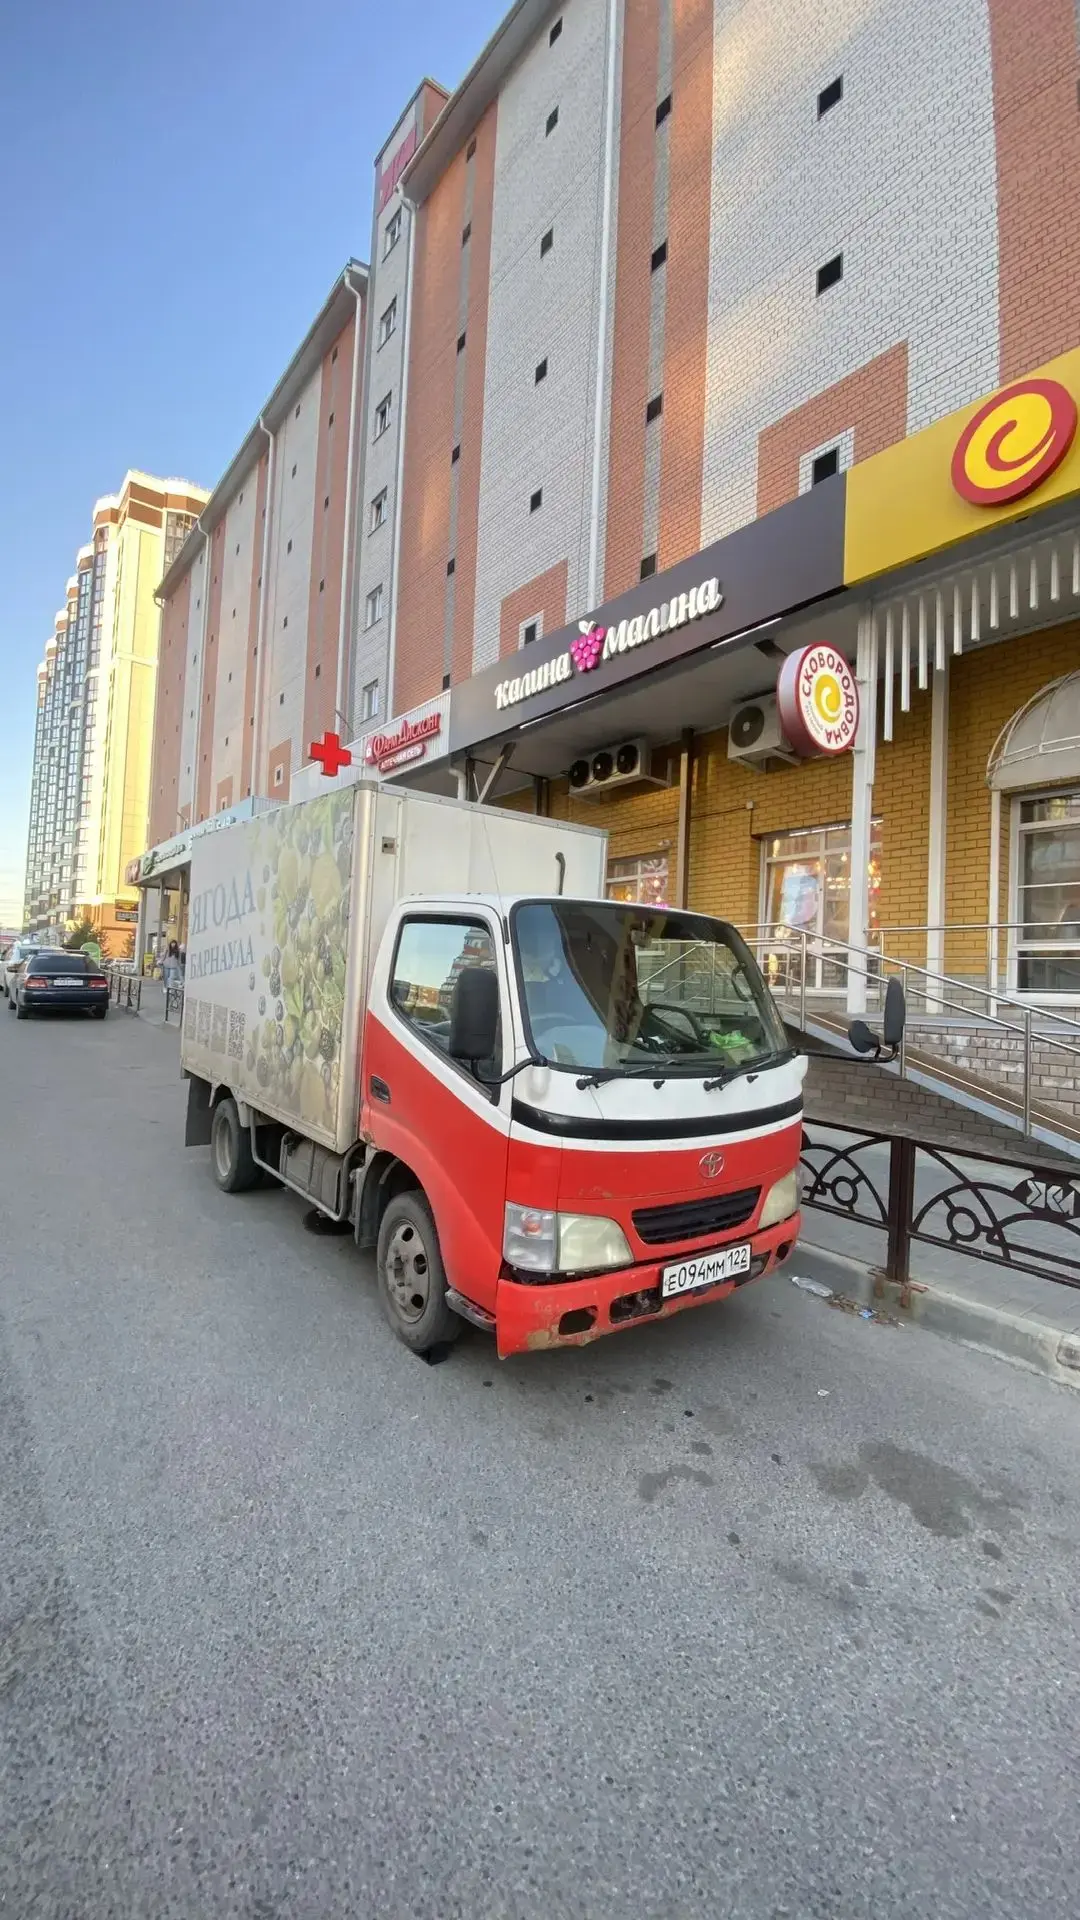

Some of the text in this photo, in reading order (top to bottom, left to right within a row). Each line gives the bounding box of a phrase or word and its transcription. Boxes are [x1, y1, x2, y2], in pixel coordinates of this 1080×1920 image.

[802, 652, 855, 744] СКОВОРОДОВНА
[191, 868, 256, 935] ЯГОДА
[190, 934, 255, 980] БАРНАУЛА
